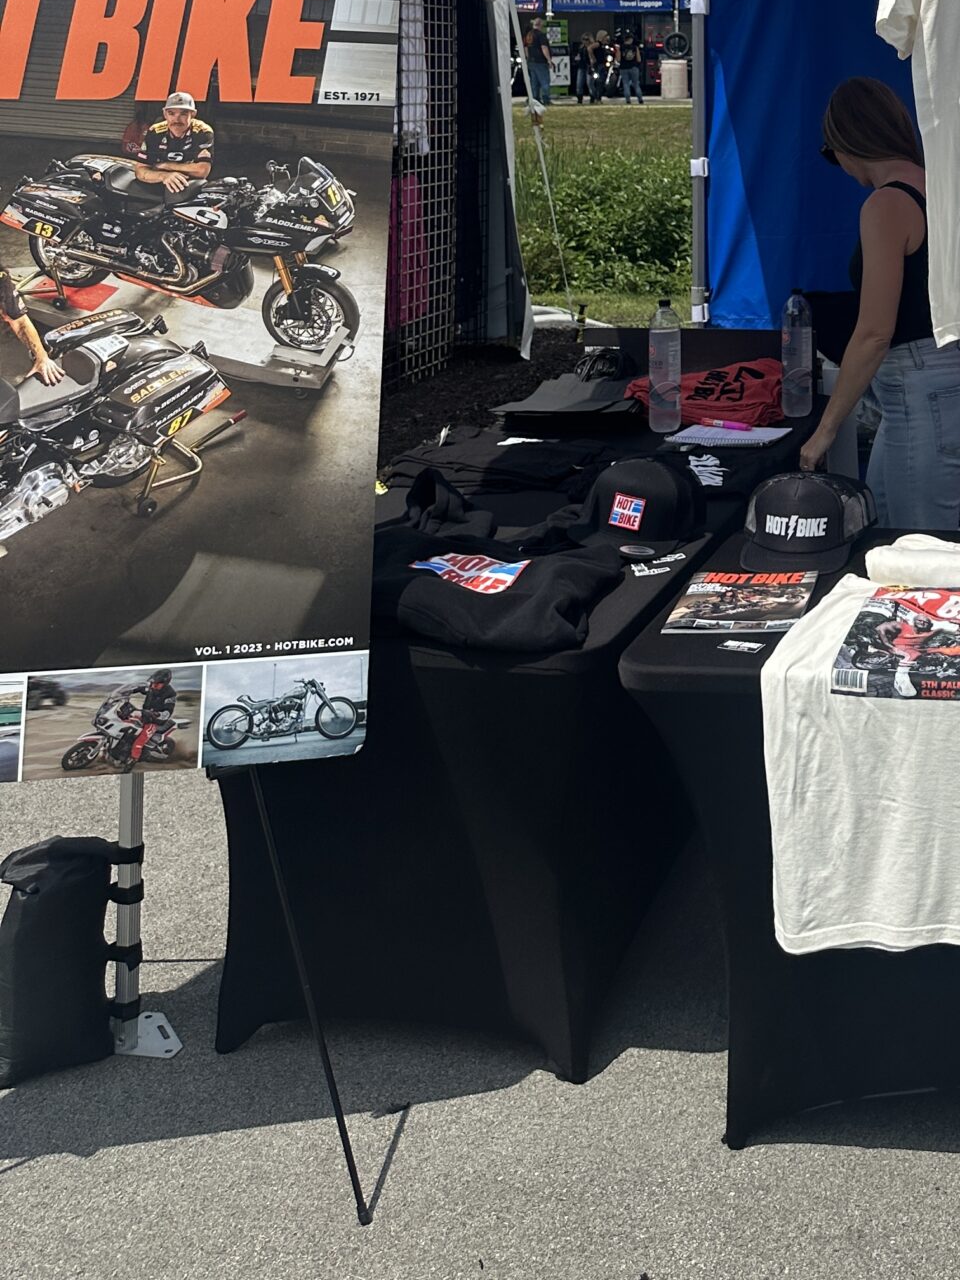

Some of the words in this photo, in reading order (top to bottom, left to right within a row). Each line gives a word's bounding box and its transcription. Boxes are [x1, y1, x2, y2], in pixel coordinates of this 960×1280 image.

[324, 90, 350, 101] EST.
[354, 91, 380, 102] 1971
[34, 221, 54, 238] 13
[265, 217, 319, 233] SADDLEMEN
[168, 408, 194, 435] 87
[616, 498, 634, 511] HOT
[618, 514, 639, 527] BIKE
[765, 514, 787, 536] HOT
[796, 516, 828, 538] BIKE
[703, 572, 753, 585] HOT
[751, 572, 805, 585] BIKE
[195, 646, 222, 656] VOL.
[225, 645, 231, 654] 1
[234, 643, 263, 653] 2023
[274, 637, 354, 651] HOTBIKE.COM
[920, 680, 938, 689] 5TH
[921, 690, 956, 698] CLASSIC
